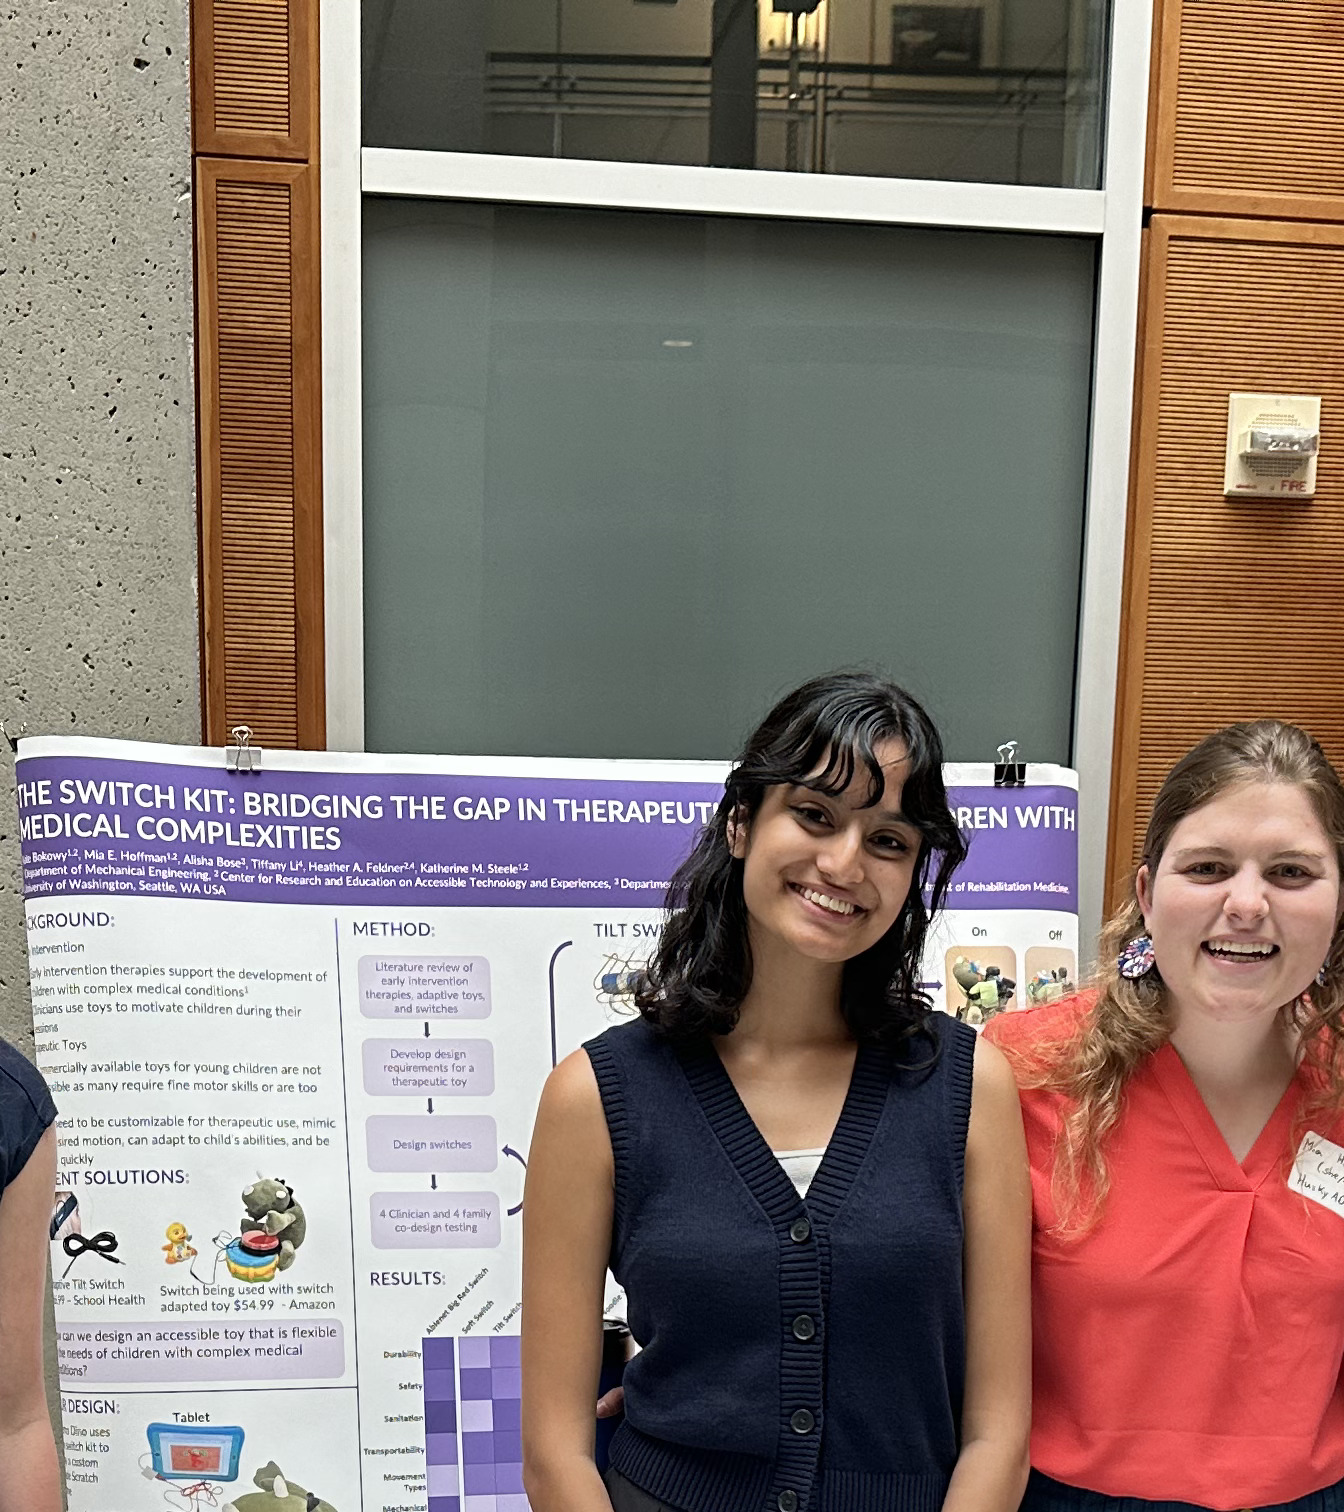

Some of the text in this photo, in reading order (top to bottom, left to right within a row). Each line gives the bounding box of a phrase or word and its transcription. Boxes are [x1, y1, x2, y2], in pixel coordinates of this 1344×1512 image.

[1280, 480, 1306, 491] FIRE
[18, 779, 52, 809] THE
[59, 779, 175, 811] SWITCH
[184, 787, 236, 816] KIT:
[244, 791, 383, 820] BRIDGING
[390, 796, 447, 820] THE
[453, 797, 511, 822] GAP
[518, 798, 546, 822] IN
[1014, 806, 1075, 832] WITH
[20, 812, 341, 851] MEDICAL COMPLEXITIES
[84, 850, 214, 866] Mia Alisha
[85, 864, 145, 876] Mechanical
[69, 879, 226, 895] Washington, Seattle, WA USA
[470, 877, 611, 890] Technology Experiences,
[353, 921, 435, 938] METHOD:
[593, 923, 628, 937] TILT
[972, 927, 987, 936] On
[1049, 931, 1062, 940] Off
[111, 965, 327, 983] therapies support the development of
[375, 962, 473, 973] Literature review of
[366, 990, 485, 1001] therapies, adaptive toys,
[87, 1003, 301, 1018] toys to motivate children during their
[85, 1170, 190, 1185] SOLUTIONS:
[379, 1209, 491, 1220] 4 Clinician and 4 family
[370, 1271, 446, 1286] RESULTS:
[160, 1284, 334, 1298] Switch being used with switch
[160, 1300, 274, 1314] adapted toy $54.99
[94, 1326, 336, 1343] design an accessible toy that is flexible
[68, 1399, 120, 1414] DESIGN:
[172, 1412, 210, 1423] Tablet
